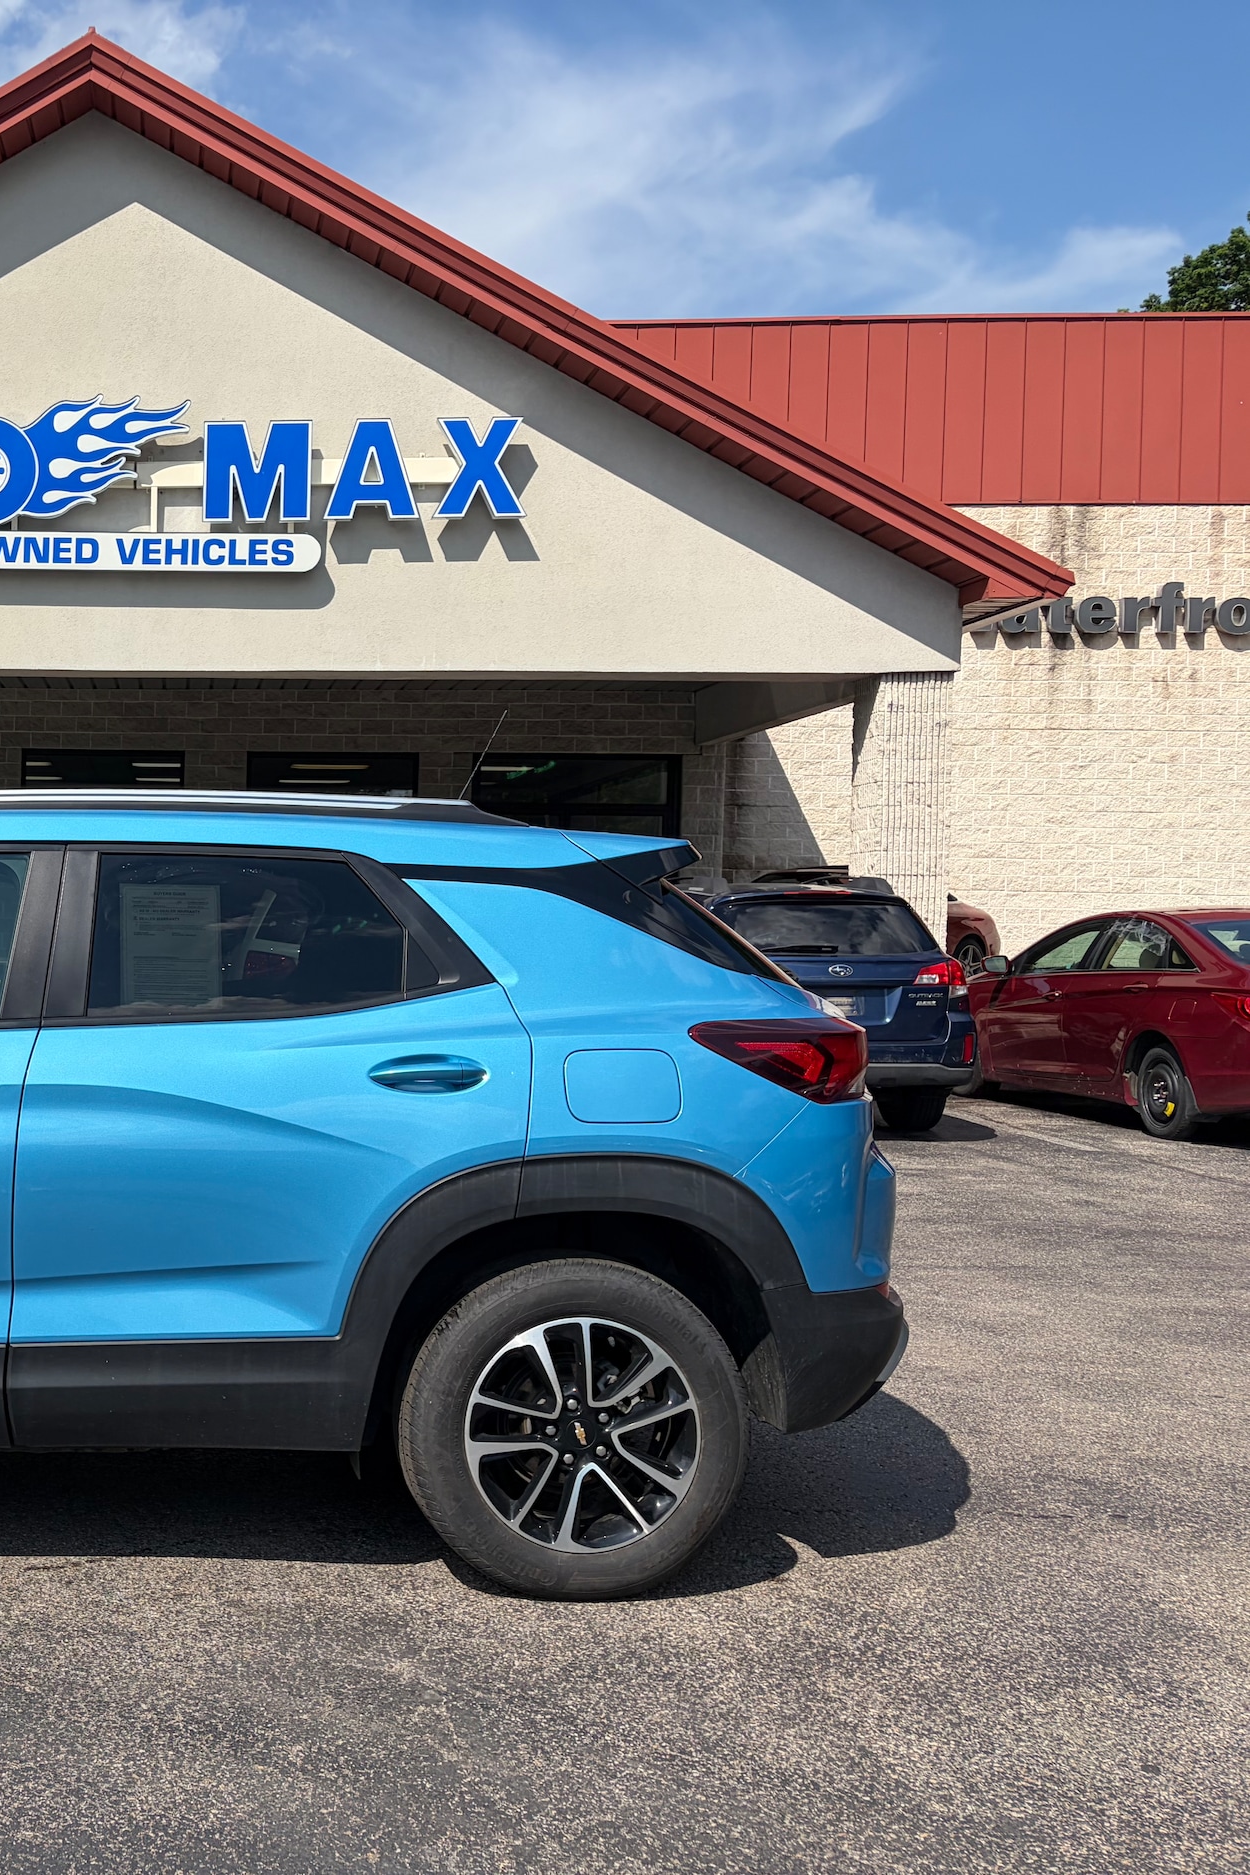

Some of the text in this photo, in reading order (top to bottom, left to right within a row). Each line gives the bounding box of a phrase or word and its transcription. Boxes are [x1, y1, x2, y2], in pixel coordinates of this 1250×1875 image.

[203, 416, 526, 523] MAX
[115, 537, 295, 567] VEHICLES
[968, 581, 1250, 635] aterfro
